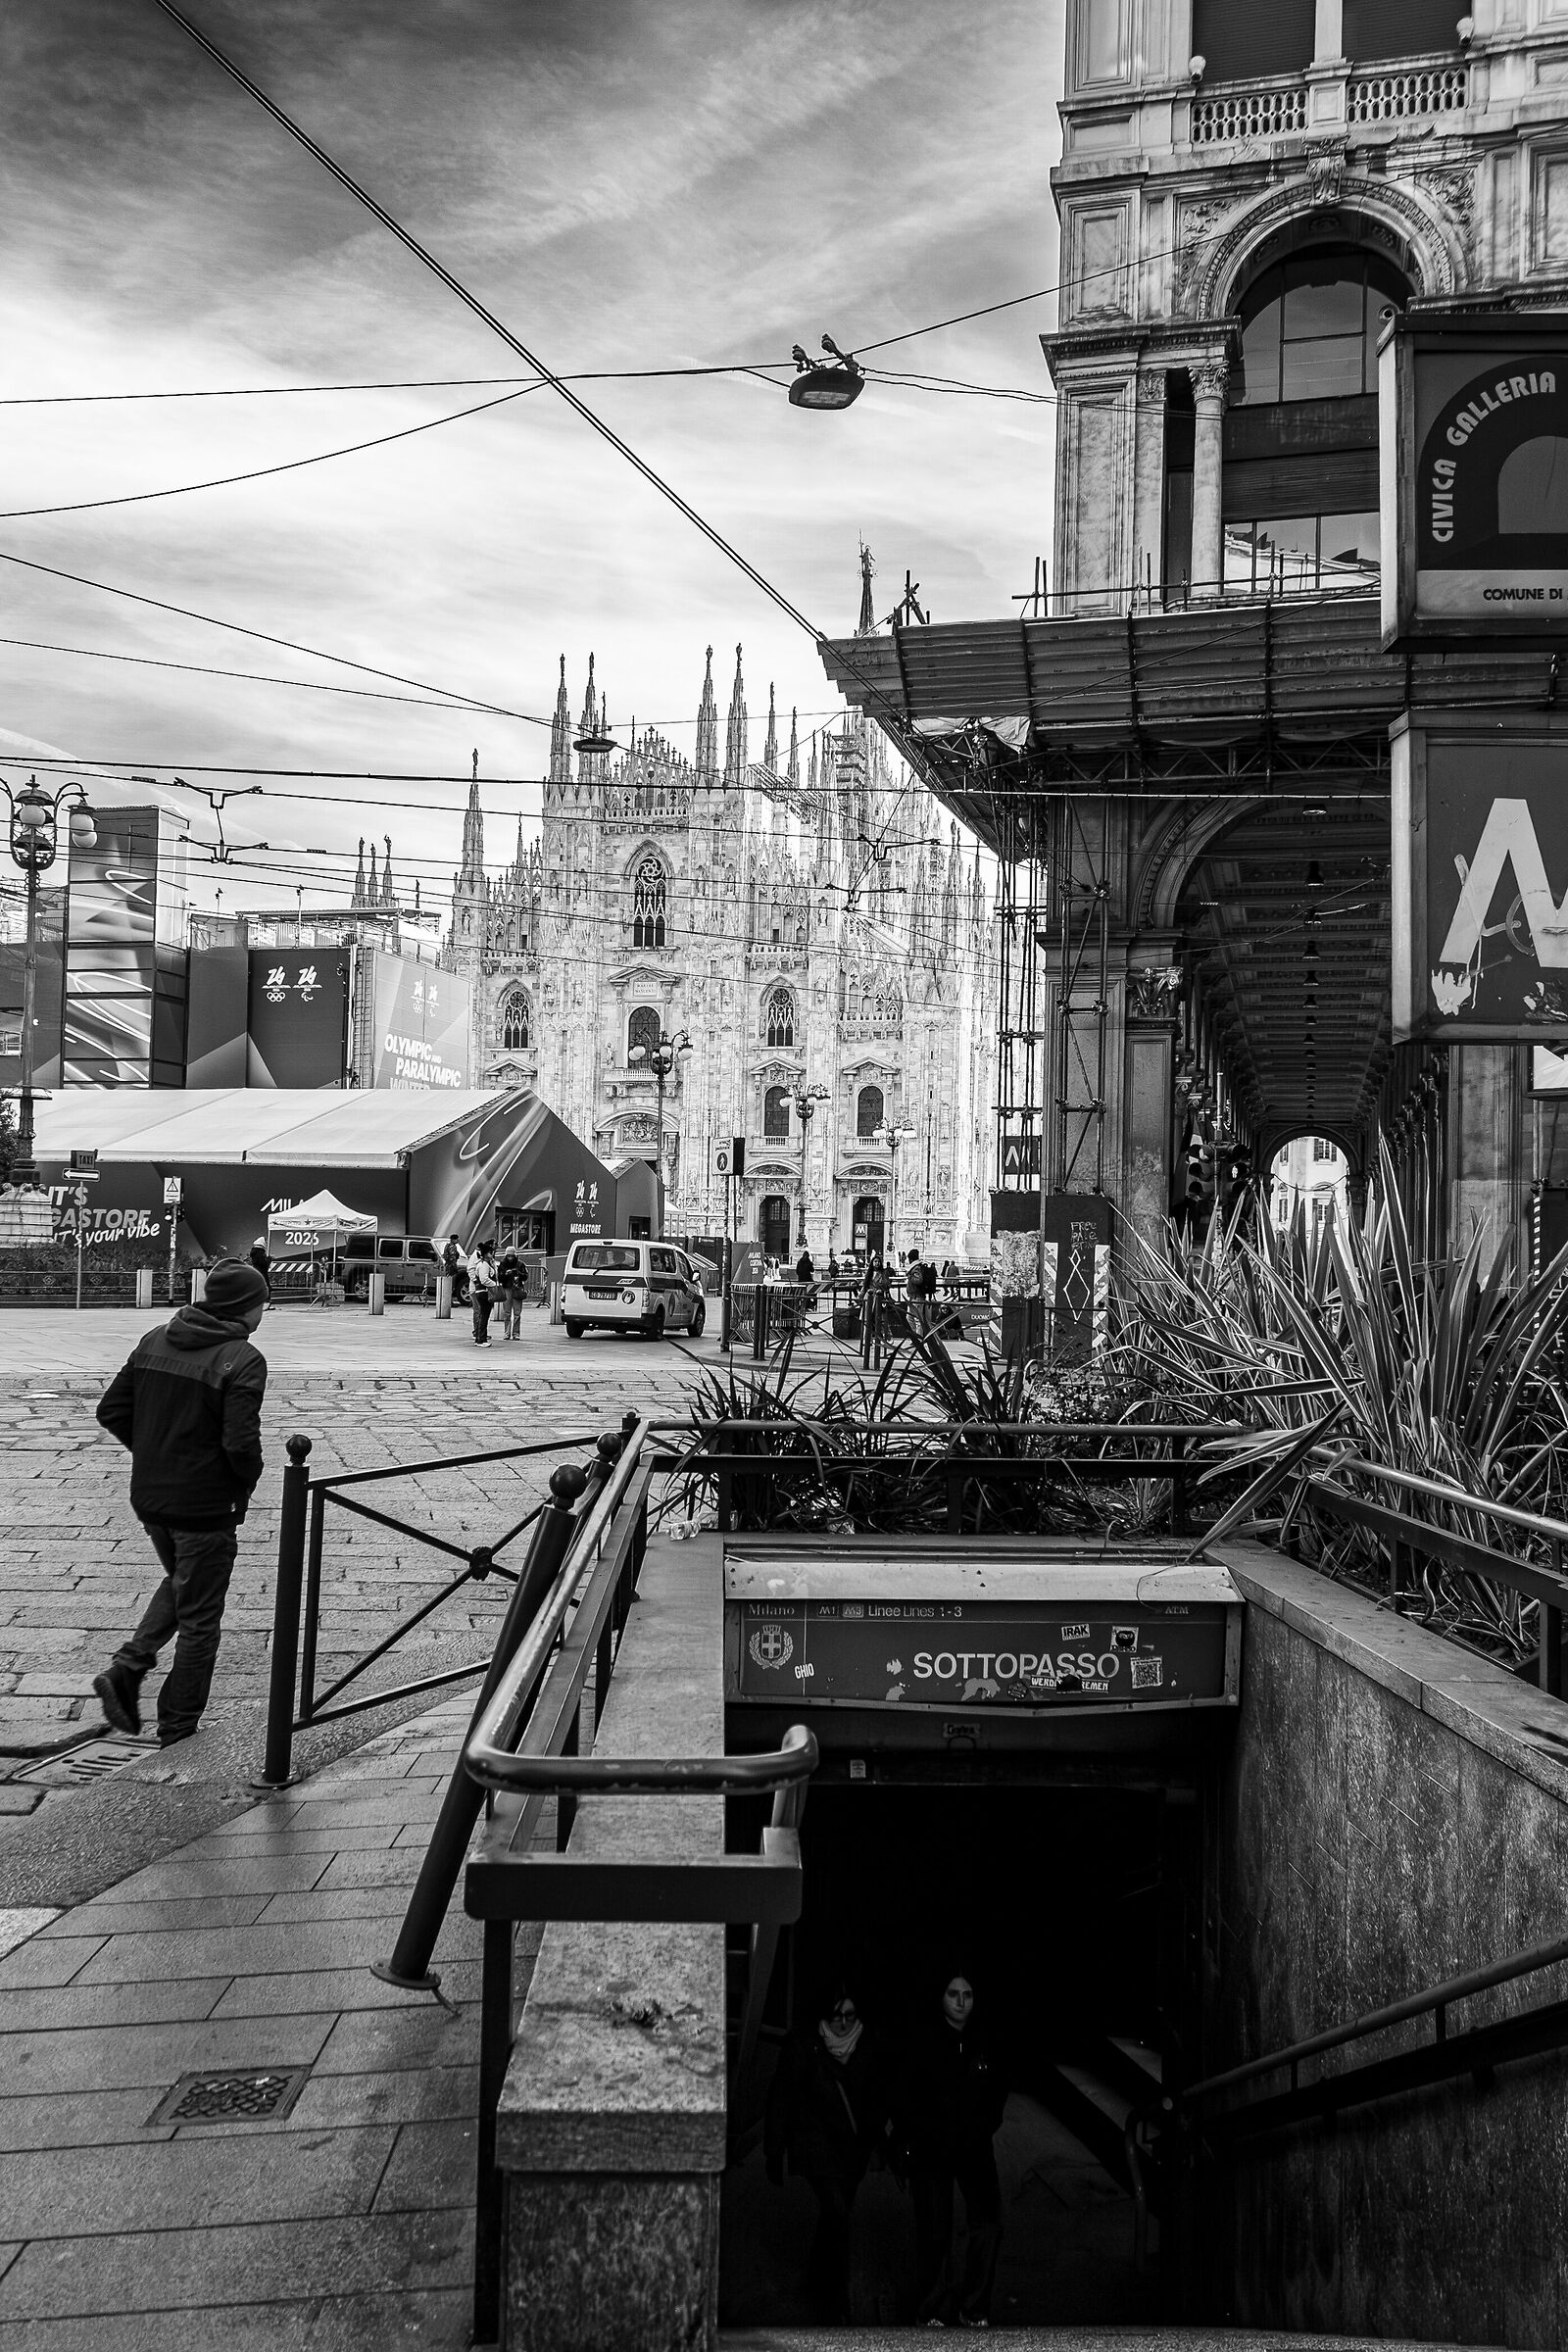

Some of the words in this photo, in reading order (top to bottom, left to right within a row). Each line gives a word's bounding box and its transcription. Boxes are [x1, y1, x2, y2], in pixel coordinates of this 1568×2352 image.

[1432, 459, 1456, 542] CIVICA
[1446, 371, 1556, 446] GALLERIA
[1483, 589, 1544, 601] COMUNE
[1548, 589, 1563, 600] DI
[384, 1033, 433, 1061] OLYMPIC
[395, 1056, 462, 1088] PARALYMPIC
[78, 1154, 94, 1165] TAXI
[260, 1198, 304, 1212] MIL
[51, 1207, 152, 1229] GASTORE
[85, 1228, 124, 1249] your
[127, 1217, 160, 1239] vibe
[569, 1223, 602, 1235] MEGASTORE
[284, 1231, 319, 1246] 2026
[749, 1603, 795, 1615] Milano
[868, 1604, 901, 1617] Linee
[904, 1604, 935, 1617] Lines
[954, 1606, 962, 1617] 3
[1165, 1606, 1189, 1615] ATM
[1063, 1625, 1089, 1638] IRAK
[794, 1663, 814, 1679] GHIO
[912, 1651, 1120, 1680] SOTTOPASSO
[1031, 1677, 1057, 1688] WERD
